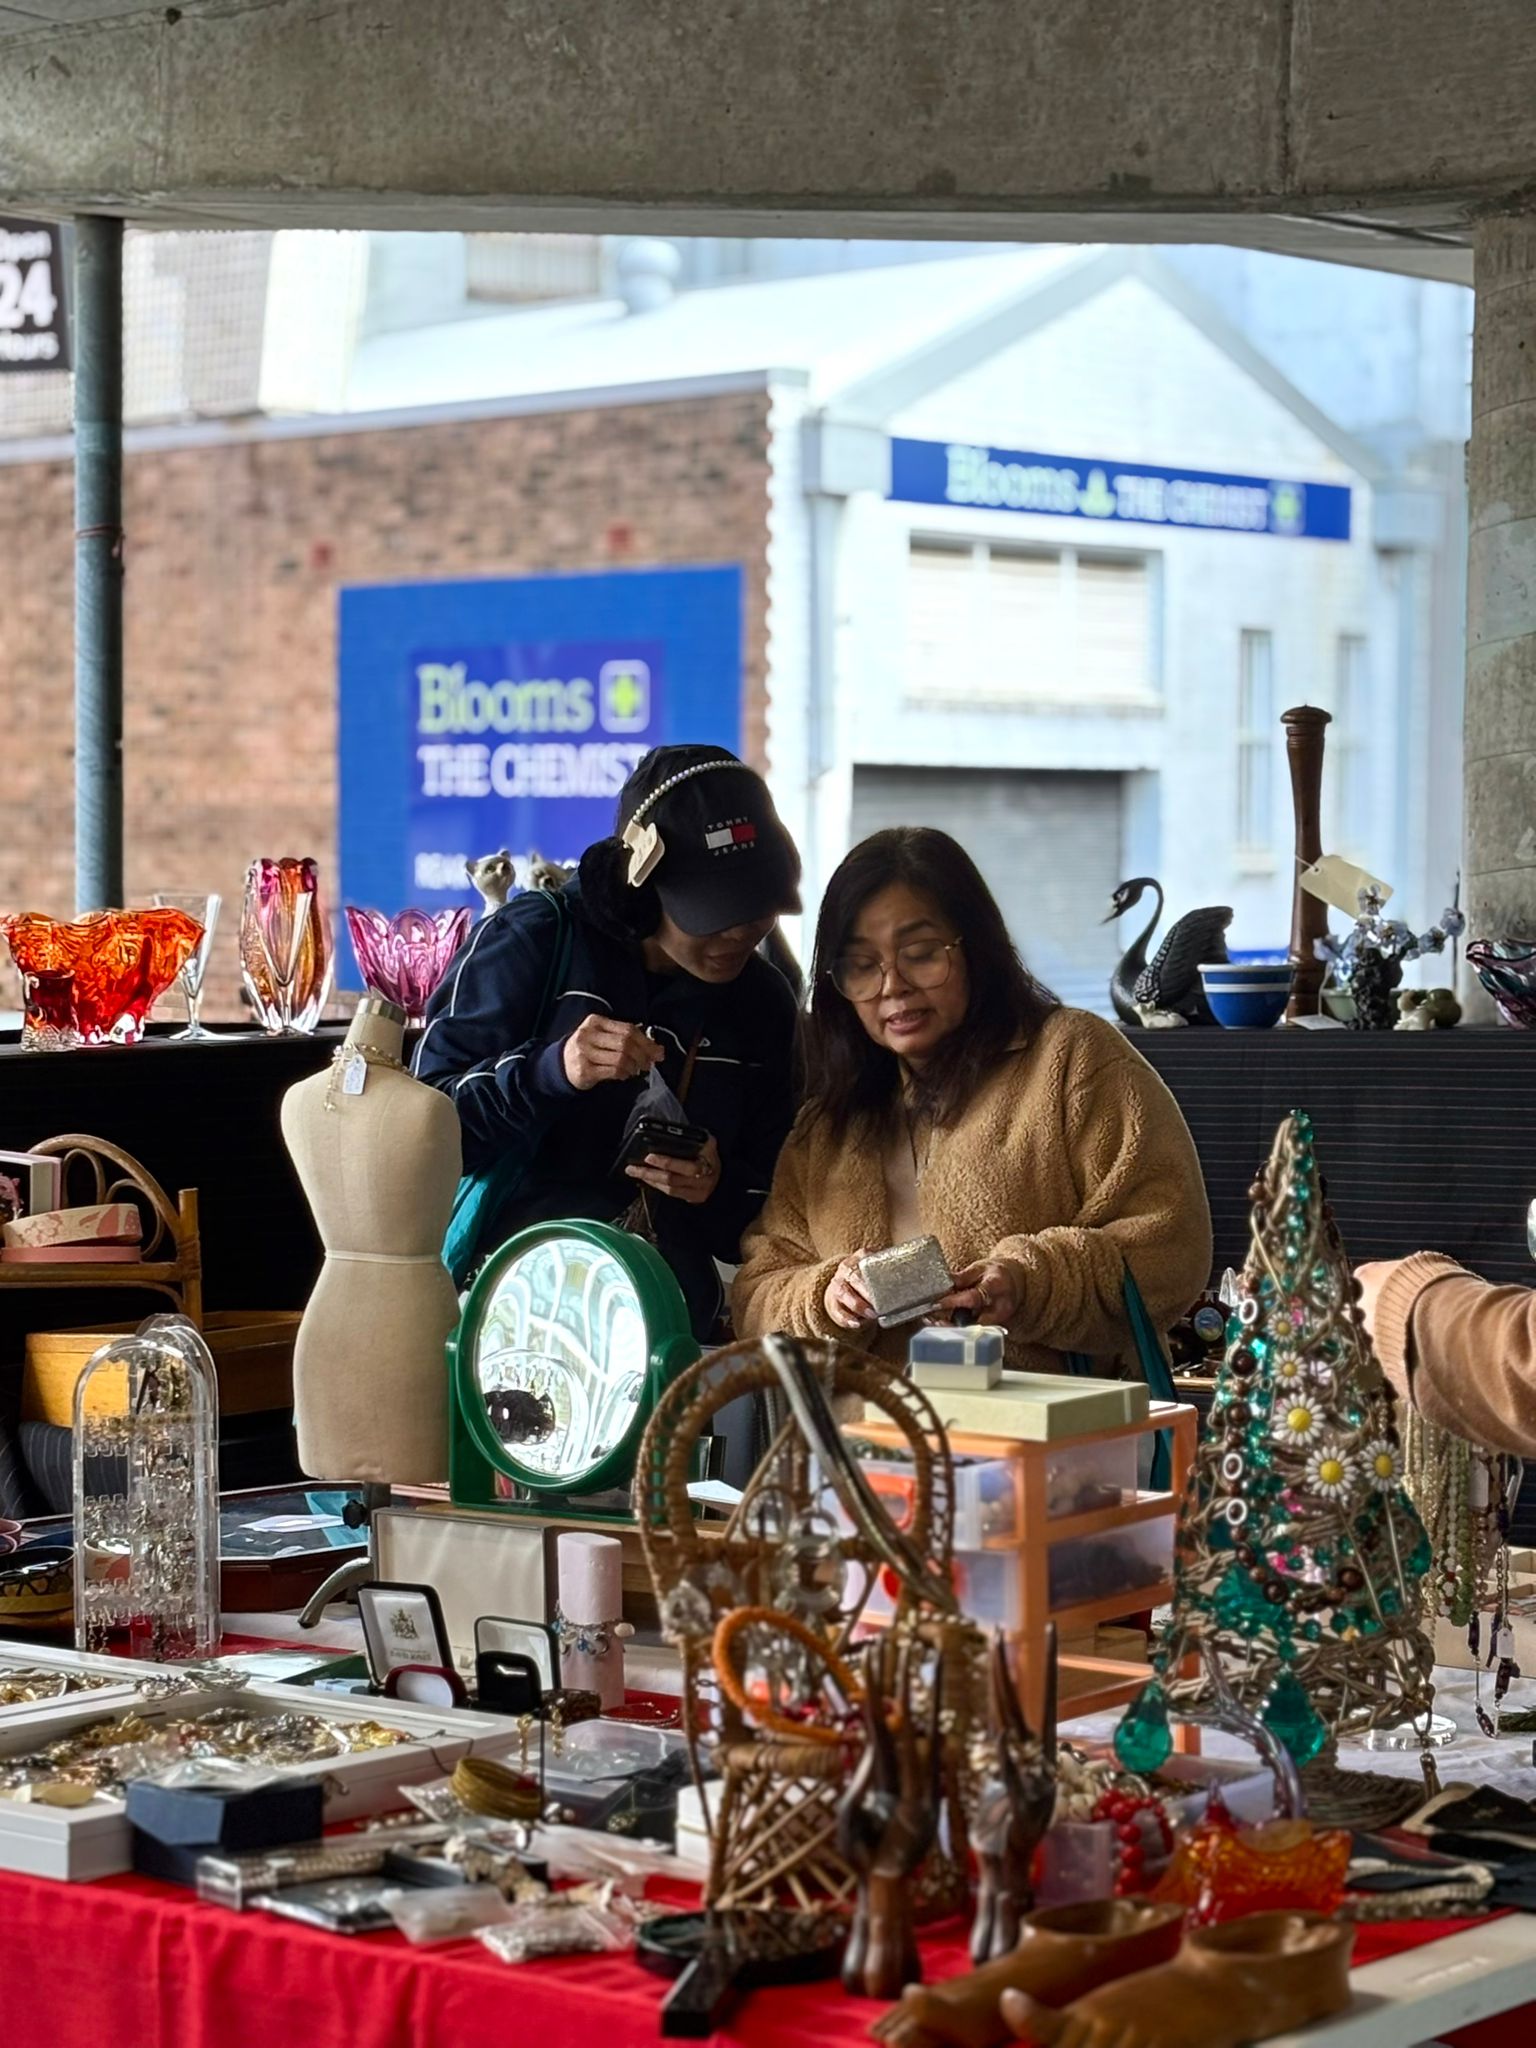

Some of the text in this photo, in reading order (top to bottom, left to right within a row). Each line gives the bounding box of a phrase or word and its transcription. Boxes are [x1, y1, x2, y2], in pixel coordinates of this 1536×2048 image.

[0, 259, 58, 329] 24
[945, 444, 1080, 513] Blooms
[416, 661, 596, 735] Blooms
[416, 743, 492, 797] THE
[713, 840, 755, 857] JEANS
